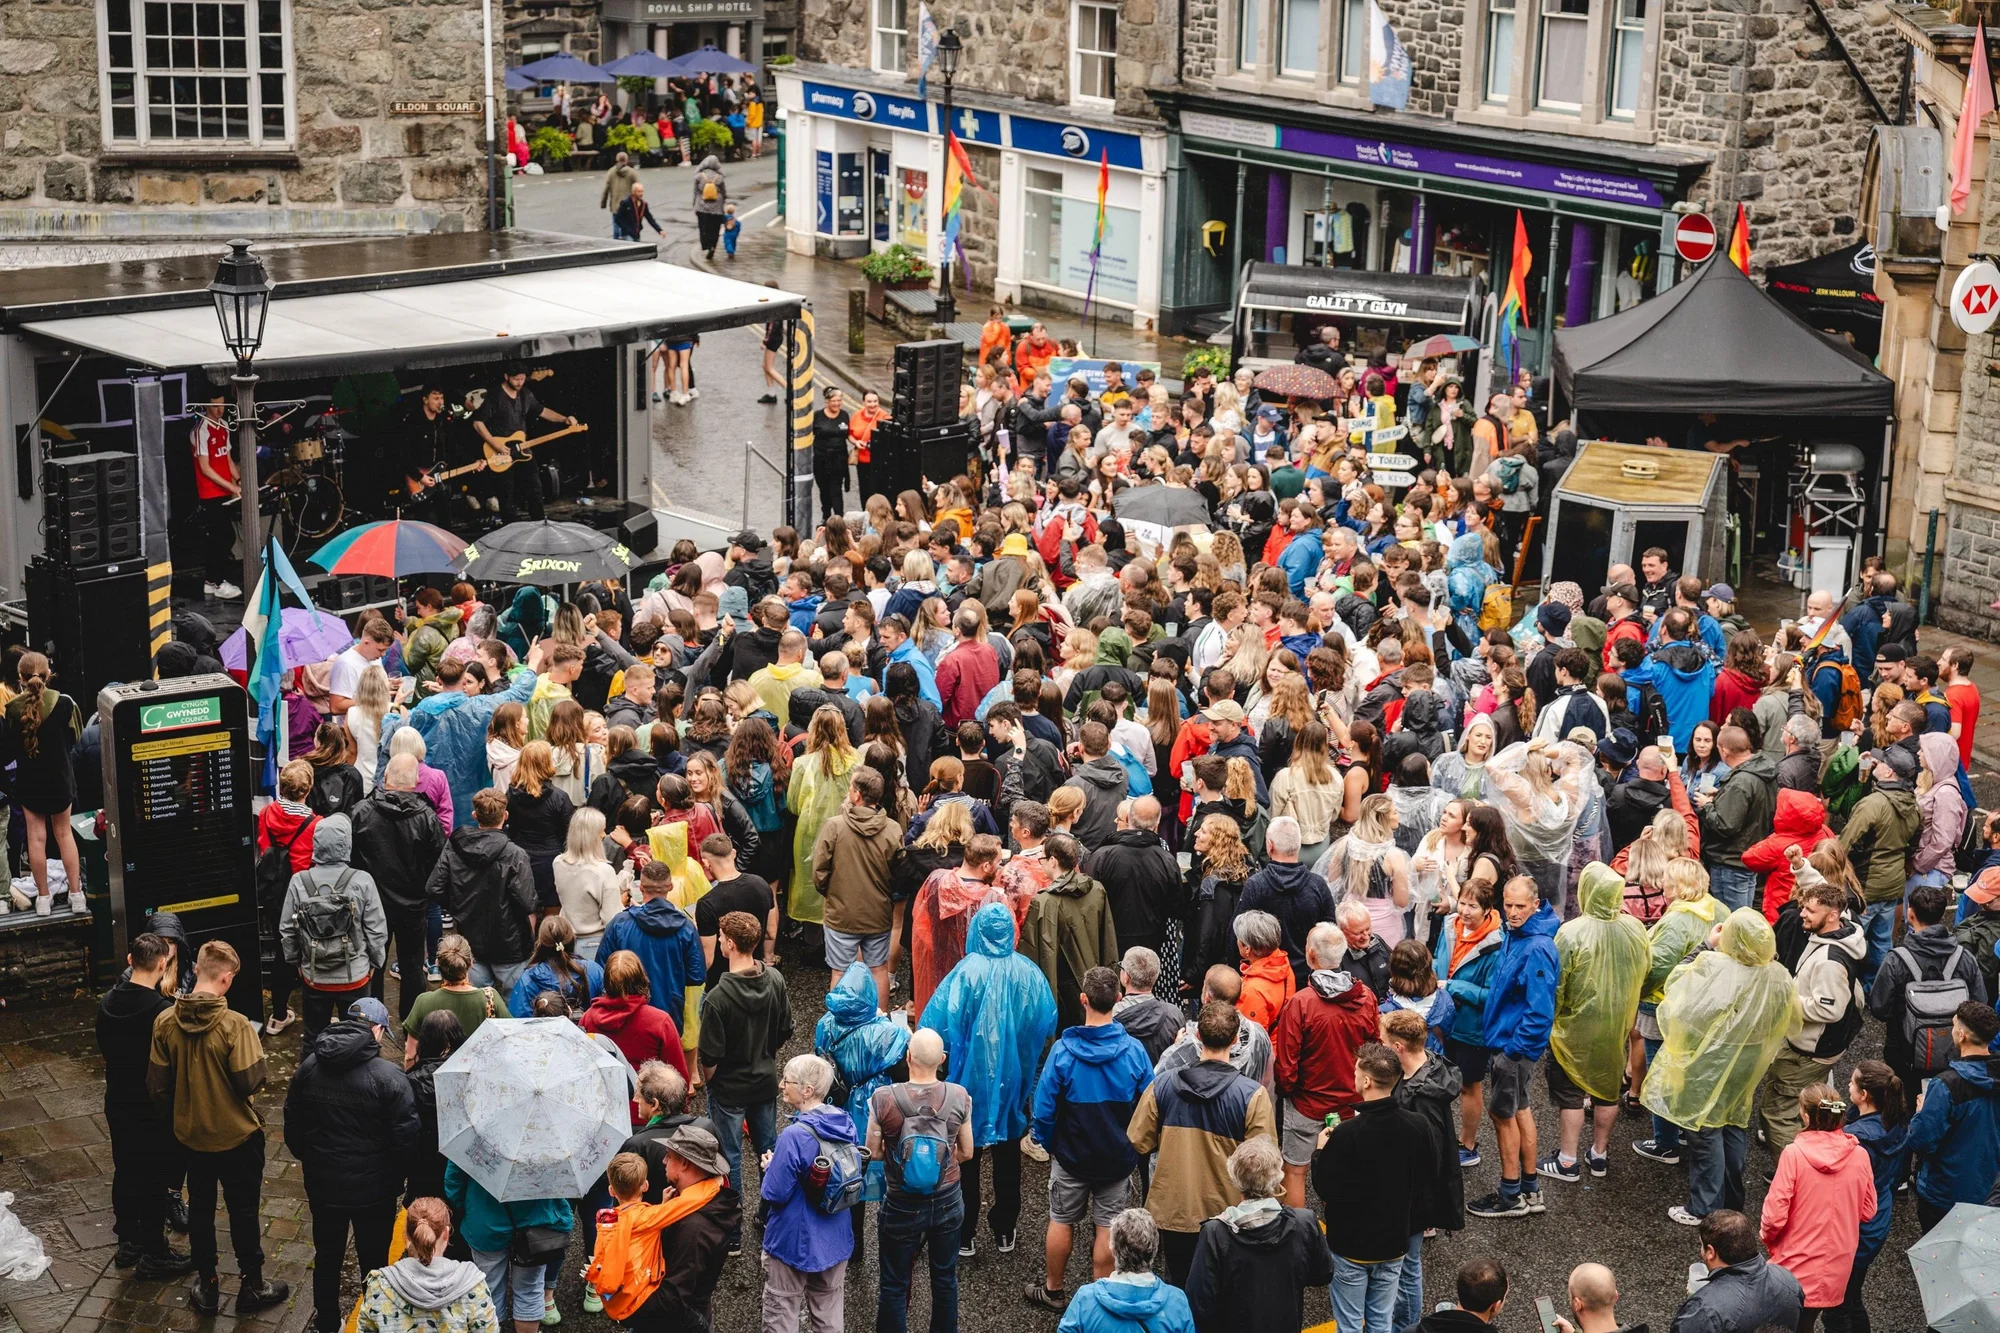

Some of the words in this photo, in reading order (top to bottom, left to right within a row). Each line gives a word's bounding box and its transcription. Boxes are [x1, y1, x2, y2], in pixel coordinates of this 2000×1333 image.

[647, 4, 684, 14] ROYAL
[687, 3, 714, 13] SHIP
[717, 2, 753, 12] HOTEL
[811, 91, 844, 109] pharmacy
[395, 102, 428, 111] ELDON
[435, 102, 475, 112] SQUARE
[1392, 156, 1419, 168] Hospice
[1617, 190, 1647, 201] community
[1815, 287, 1828, 296] JERK
[1828, 288, 1856, 298] HALLOUMI
[1305, 295, 1353, 311] GALLT
[1356, 299, 1368, 312] Y
[1370, 301, 1408, 315] GLYN
[1368, 455, 1374, 464] Y
[516, 557, 582, 578] SRIXON
[181, 700, 209, 709] CYNGOR
[166, 706, 210, 719] GWYNEDD
[180, 715, 209, 724] COUNCIL
[134, 743, 156, 751] Dolgellau
[157, 741, 168, 749] High
